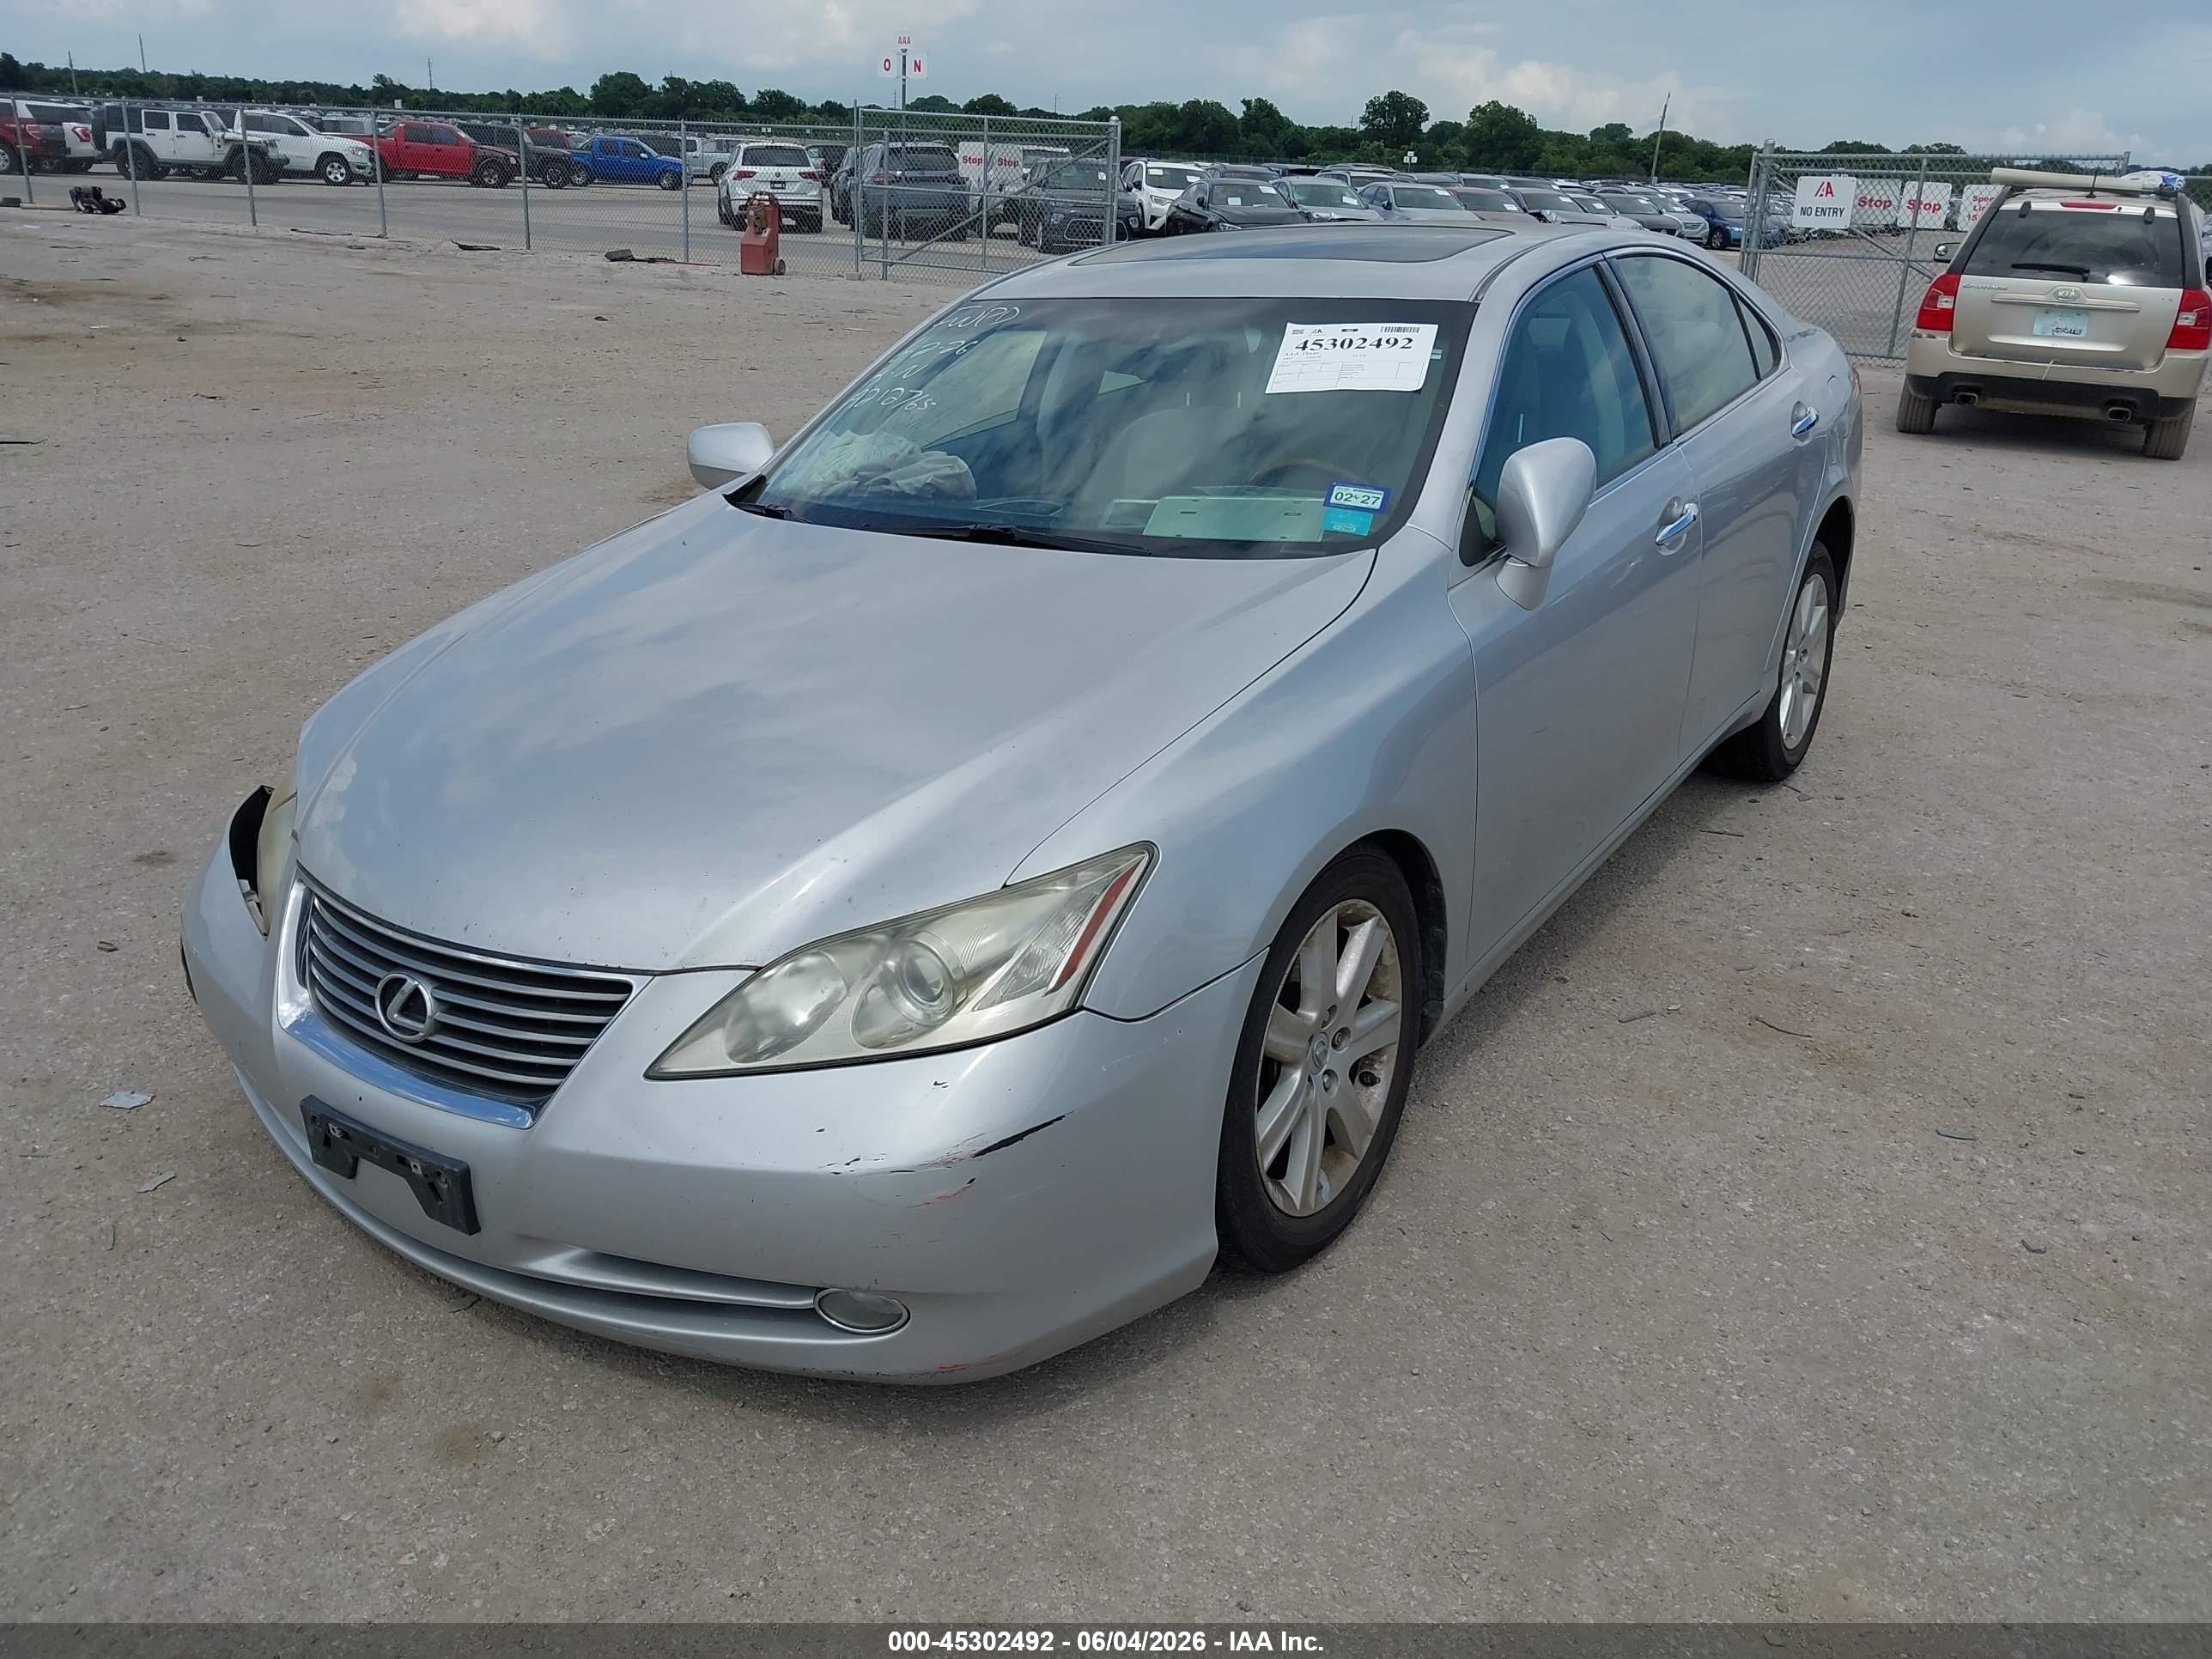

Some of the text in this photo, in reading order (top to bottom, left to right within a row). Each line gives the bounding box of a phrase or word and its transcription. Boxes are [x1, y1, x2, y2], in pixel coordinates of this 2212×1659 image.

[897, 36, 911, 45] AAA
[883, 58, 891, 71] O
[914, 59, 921, 73] N
[962, 155, 983, 166] Stop
[997, 157, 1019, 168] Stop
[1857, 196, 1893, 211] Stop
[1800, 206, 1845, 217] NO ENTRY
[2057, 289, 2075, 298] KIA
[1294, 337, 1413, 351] 45302492
